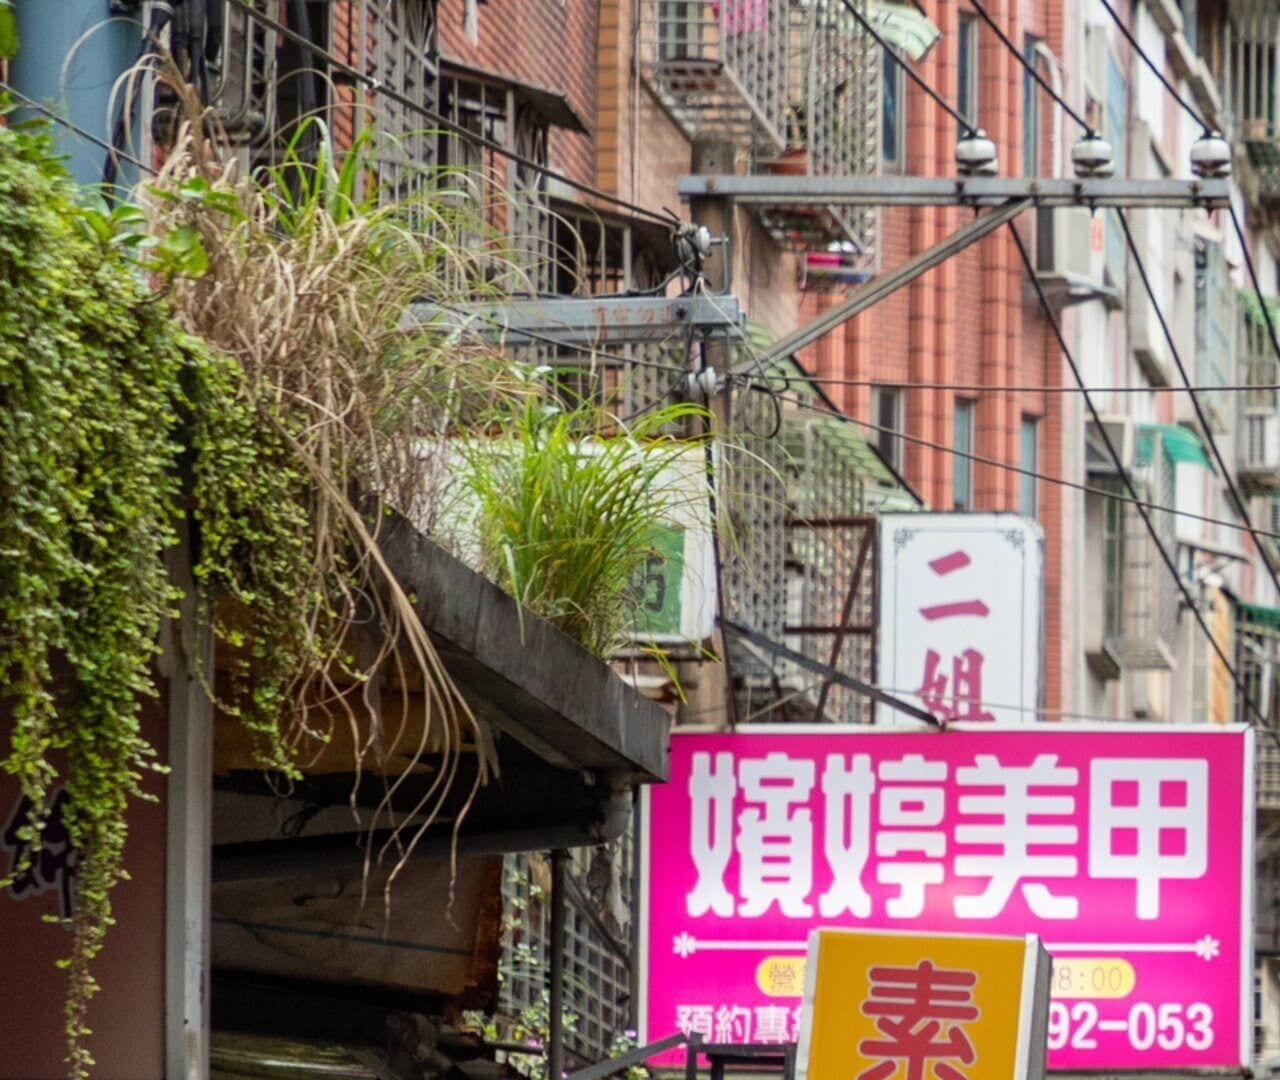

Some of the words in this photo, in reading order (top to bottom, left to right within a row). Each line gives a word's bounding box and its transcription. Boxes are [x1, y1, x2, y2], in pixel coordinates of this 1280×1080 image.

[914, 549, 996, 722] 二姐
[686, 751, 1209, 921] 嬪婷美甲
[675, 1003, 803, 1045] 預約專
